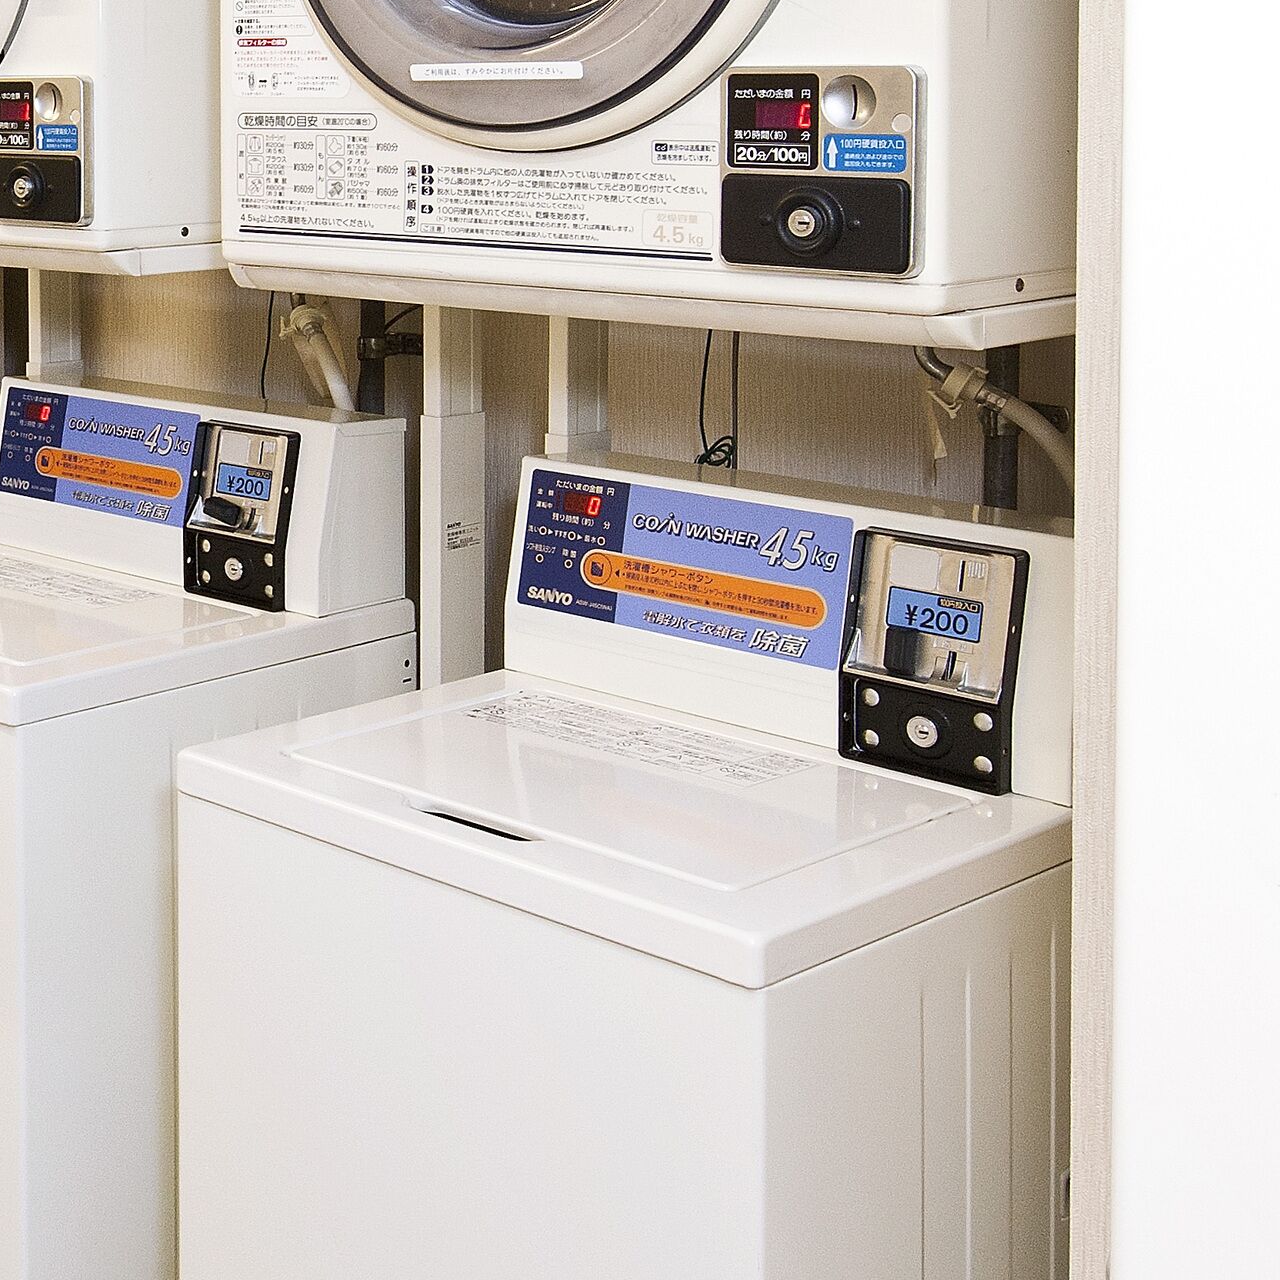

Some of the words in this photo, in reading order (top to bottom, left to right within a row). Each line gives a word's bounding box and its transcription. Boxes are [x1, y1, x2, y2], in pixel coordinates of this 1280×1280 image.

[801, 89, 811, 99] 円
[801, 131, 811, 141] 分
[736, 146, 808, 163] 20分/100円
[653, 225, 685, 243] 4.5
[688, 234, 704, 246] kg
[41, 406, 50, 421] 0
[100, 423, 145, 441] WASHER
[174, 436, 191, 455] kg
[1, 476, 30, 490] SANYO
[227, 475, 263, 496] ¥200
[135, 500, 172, 521] 除菌
[588, 495, 600, 516] 0
[685, 521, 759, 550] WASHER
[758, 526, 815, 572] 4.5
[810, 544, 839, 572] kg
[527, 586, 573, 606] SANYO
[905, 604, 968, 635] ¥200
[748, 628, 810, 659] 除菌
